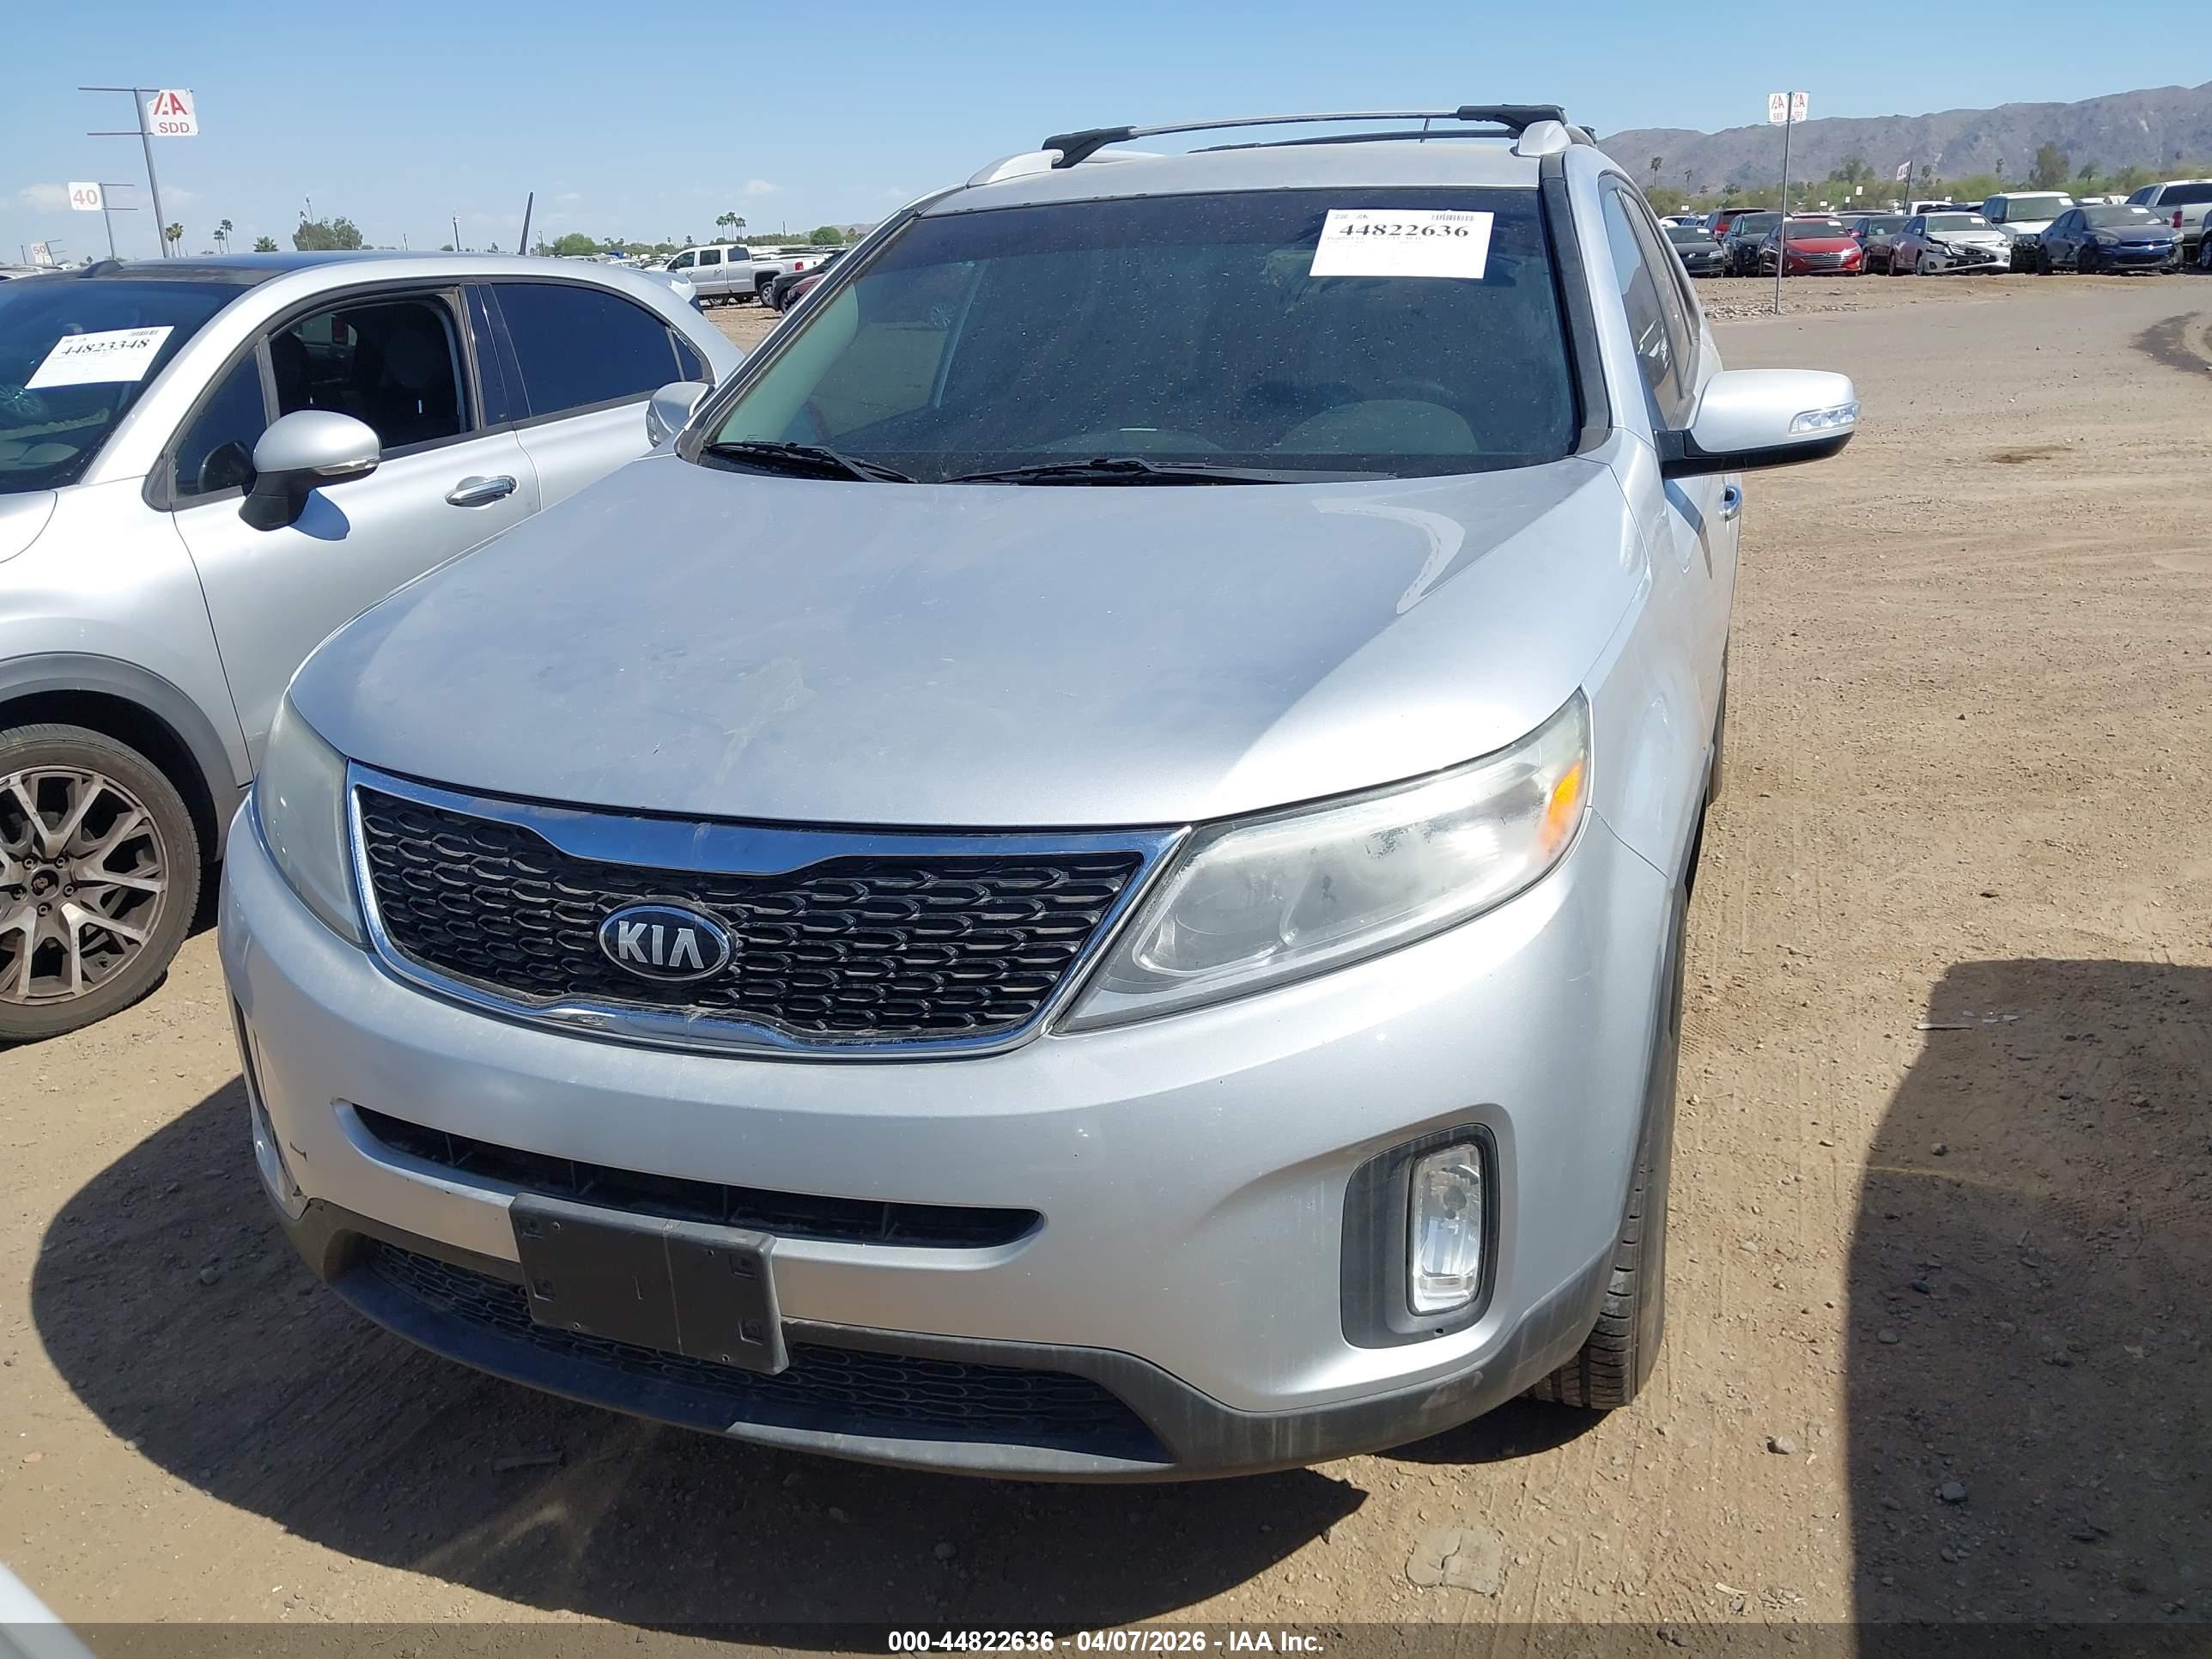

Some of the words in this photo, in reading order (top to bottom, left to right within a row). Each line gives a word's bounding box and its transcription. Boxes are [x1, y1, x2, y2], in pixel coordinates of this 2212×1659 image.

[158, 122, 190, 134] SDD
[73, 189, 98, 205] 40
[1339, 223, 1469, 238] 44822636
[61, 337, 150, 356] 44823348
[618, 921, 704, 969] KIA
